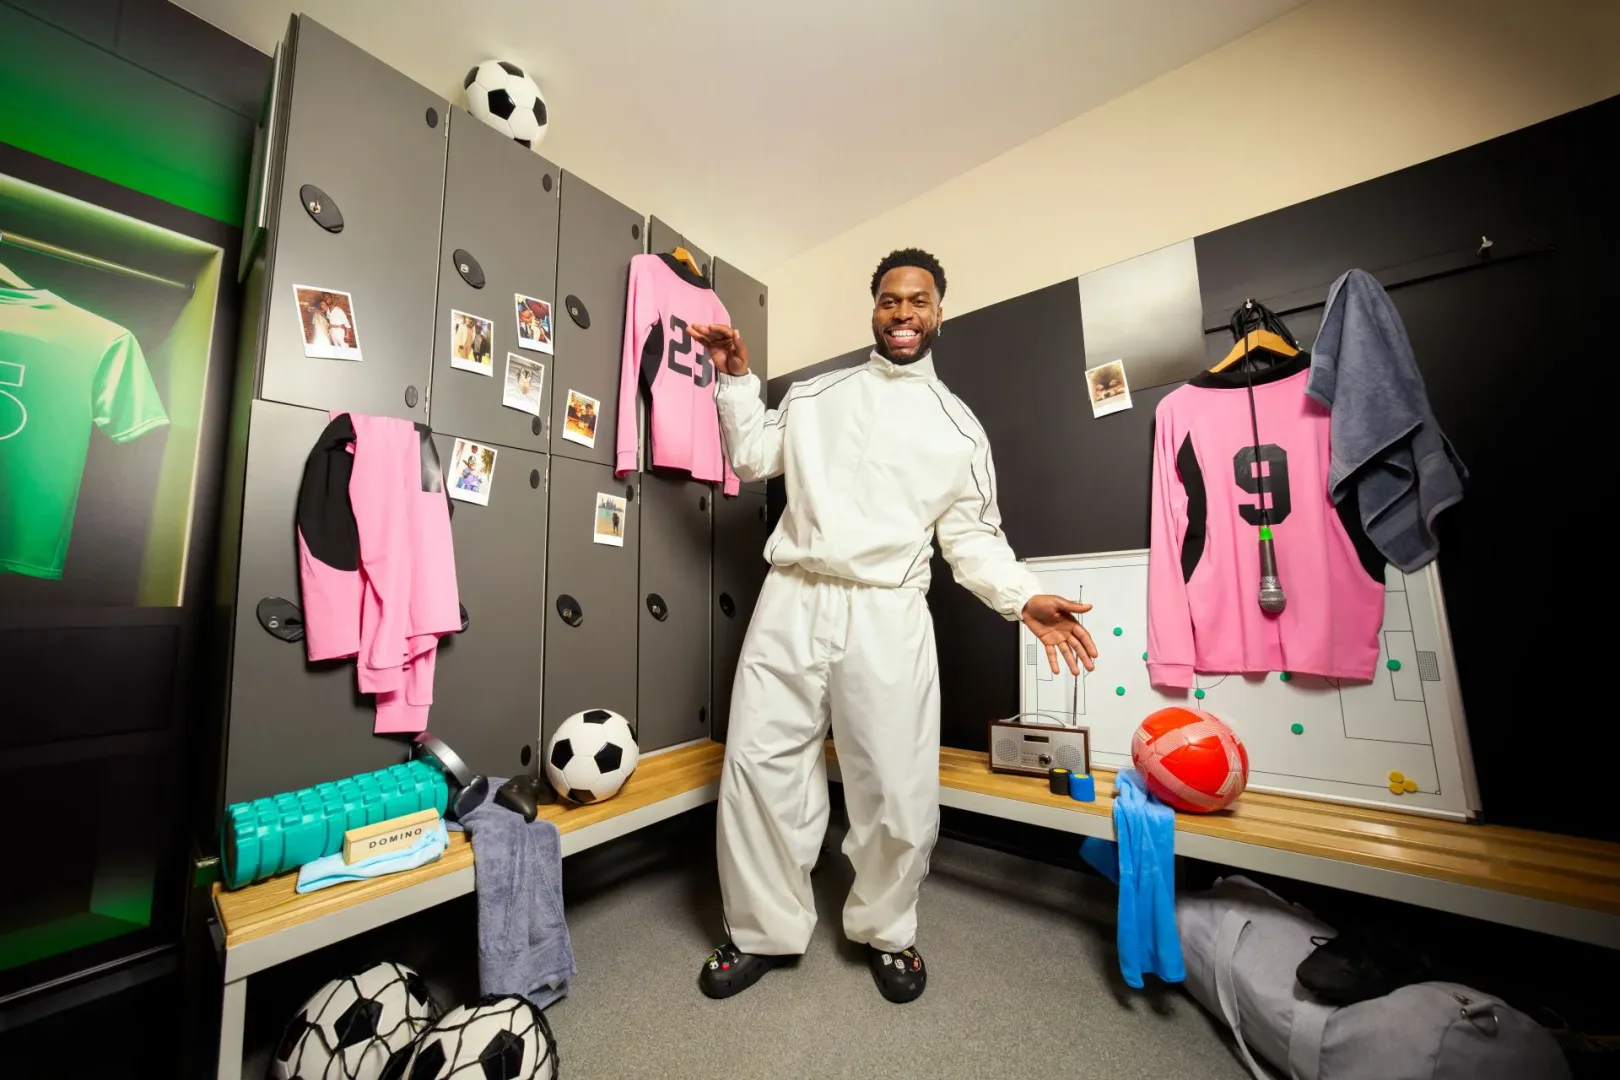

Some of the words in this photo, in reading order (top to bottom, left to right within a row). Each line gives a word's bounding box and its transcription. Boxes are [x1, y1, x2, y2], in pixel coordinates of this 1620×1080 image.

[667, 314, 713, 389] 23
[1233, 443, 1292, 526] 9
[368, 828, 423, 849] DOMINO
